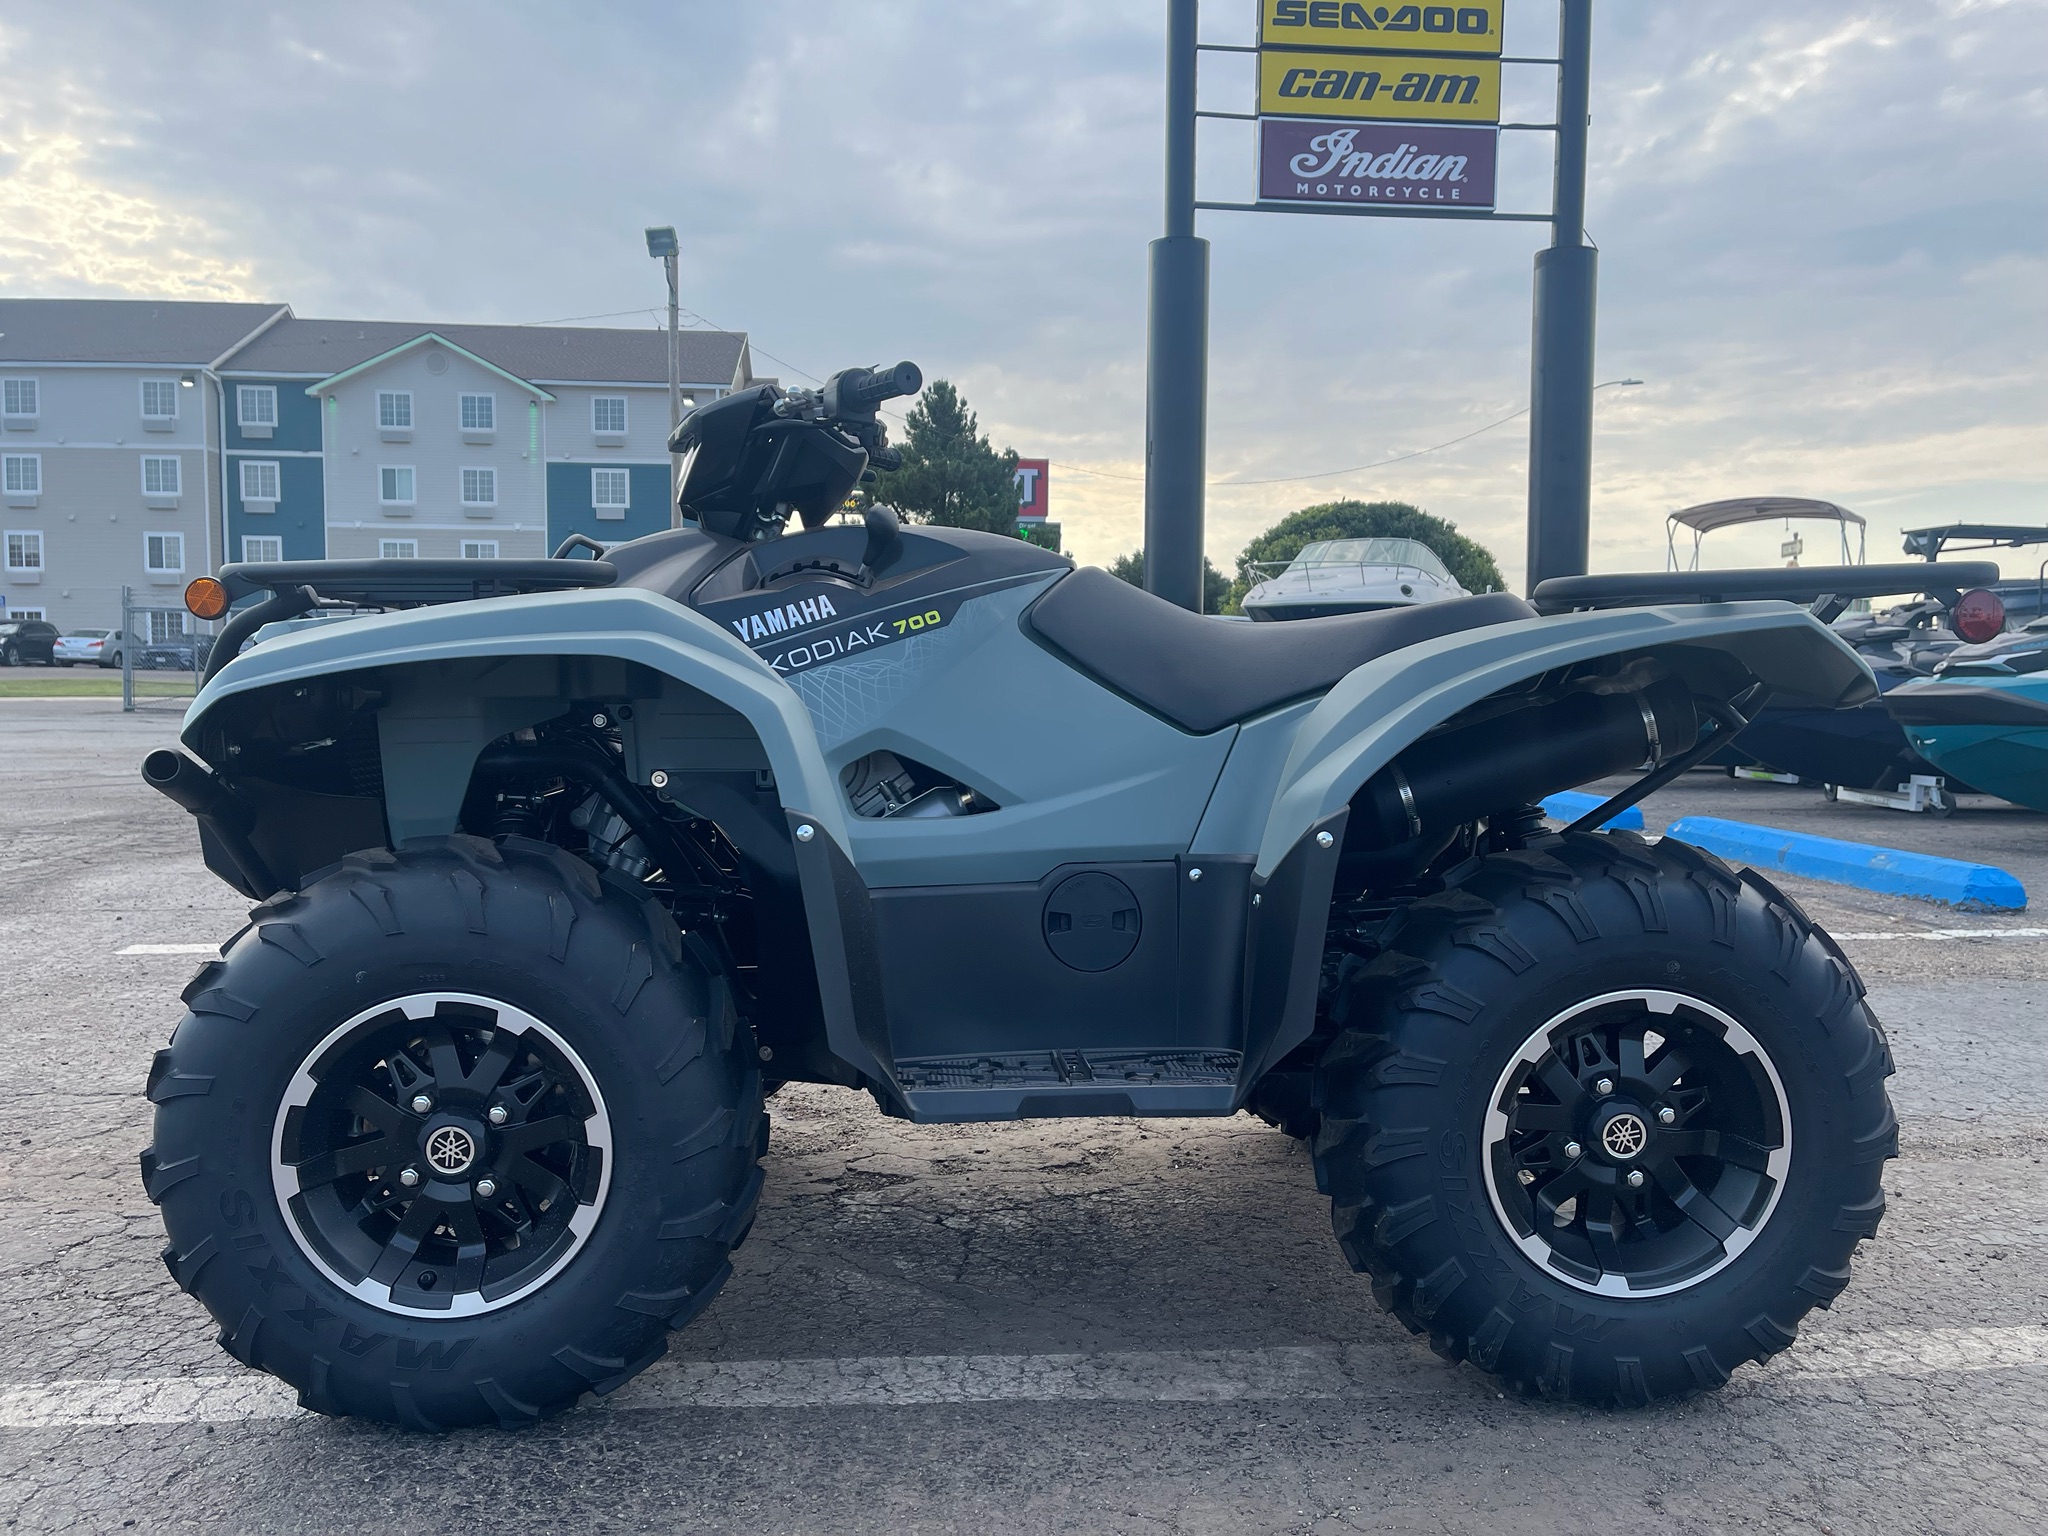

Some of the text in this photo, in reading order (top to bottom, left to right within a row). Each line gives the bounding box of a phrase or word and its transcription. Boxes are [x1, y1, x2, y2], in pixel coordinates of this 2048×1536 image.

[1278, 68, 1480, 104] can-am
[1289, 128, 1469, 182] Indian
[1297, 182, 1460, 199] MOTORCYCLE
[732, 594, 838, 642] YAMAHA
[892, 609, 942, 635] 700
[1439, 1130, 1628, 1342] MAXXIS
[219, 1188, 479, 1372] MAXXIS
